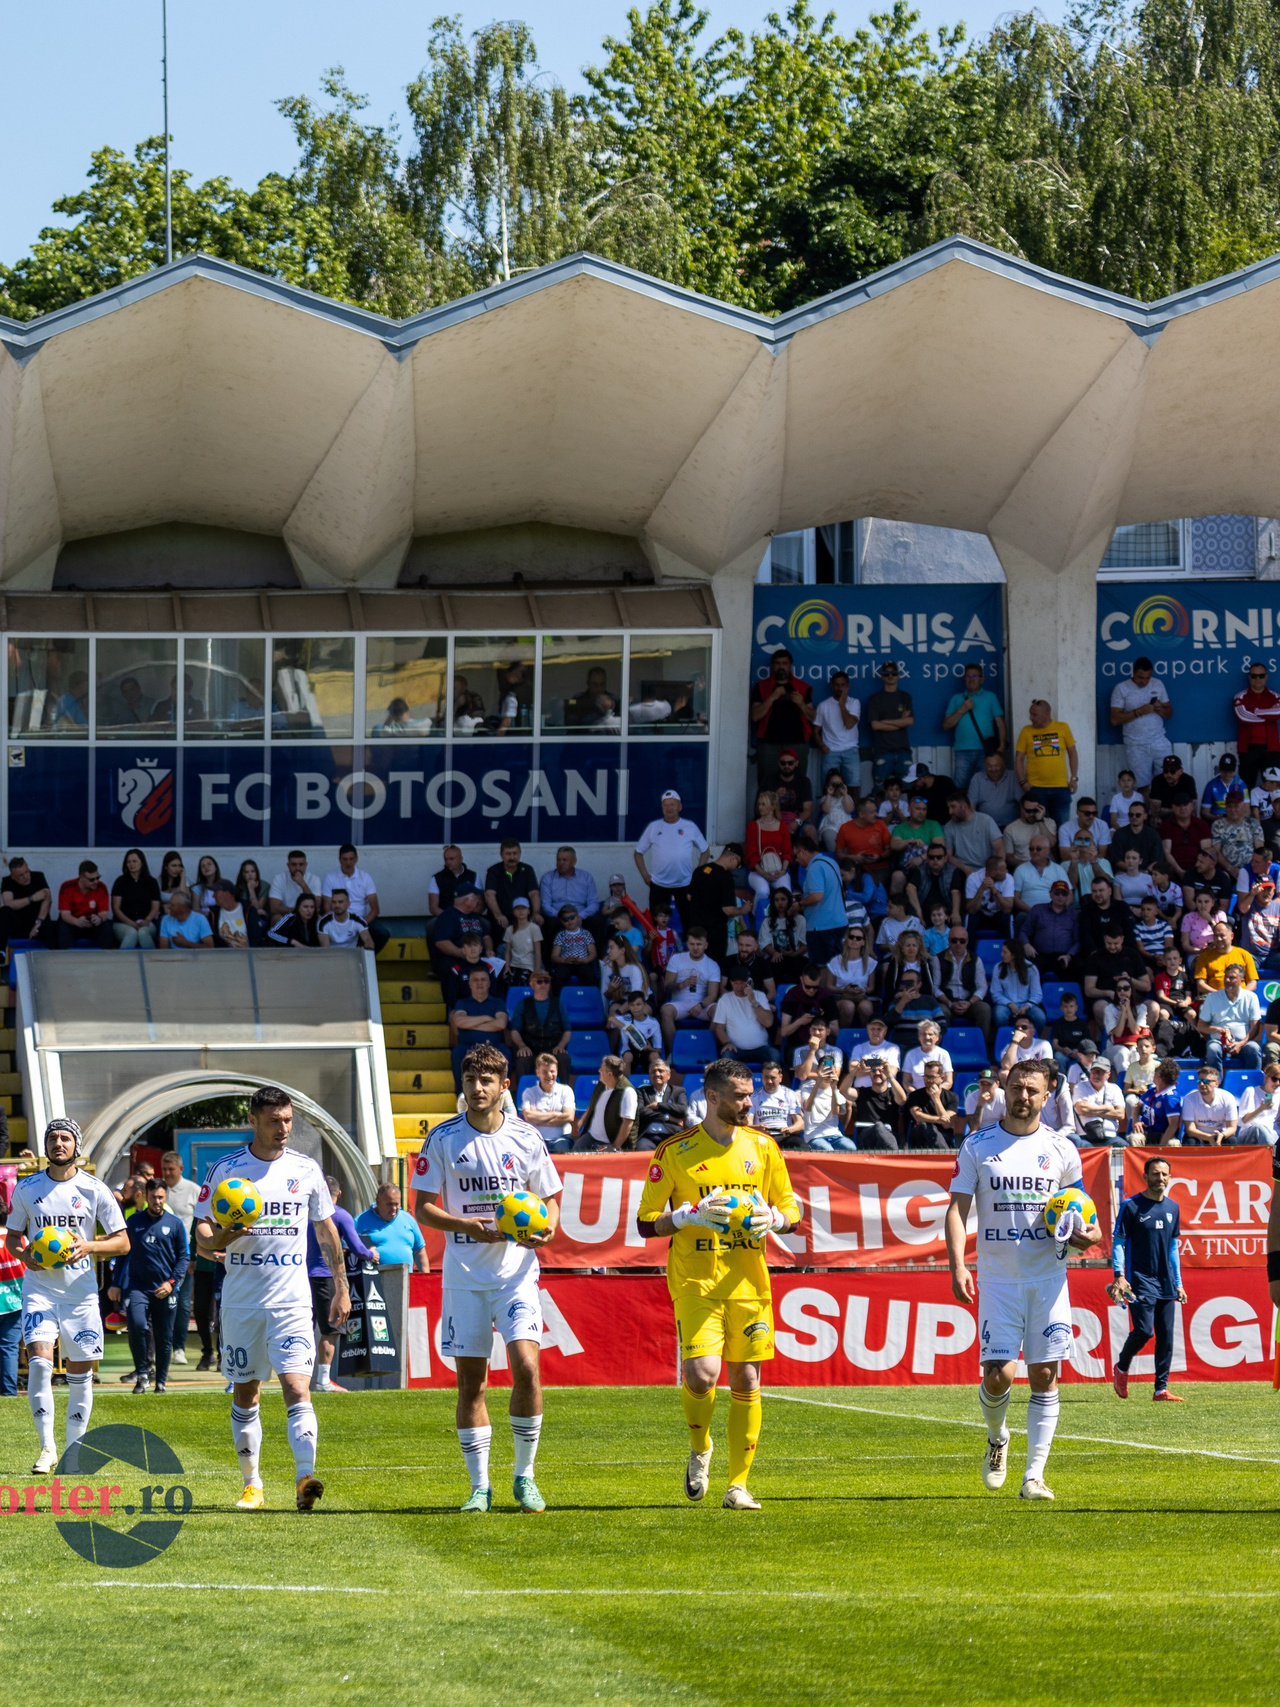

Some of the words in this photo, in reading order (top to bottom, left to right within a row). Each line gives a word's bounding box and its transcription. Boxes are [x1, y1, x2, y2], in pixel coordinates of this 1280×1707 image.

[1100, 595, 1280, 651] CORNI
[757, 659, 883, 683] auapark
[923, 658, 999, 682] spots
[1102, 655, 1229, 679] aqapark
[199, 772, 272, 821] FC
[294, 768, 629, 830] BOTOȘANI
[398, 943, 406, 958] 7
[406, 1030, 416, 1045] 5
[412, 1074, 422, 1090] 4
[420, 1120, 429, 1134] 3
[459, 1176, 518, 1192] UNIBET
[990, 1176, 1055, 1192] UNIBET
[263, 1202, 302, 1216] IBET
[35, 1216, 85, 1228] UNIBET
[272, 1227, 287, 1235] SPRE
[230, 1253, 302, 1266] ELSACO
[366, 1302, 386, 1310] SELECT
[24, 1311, 43, 1331] 20
[375, 1330, 387, 1339] LPF
[982, 1320, 990, 1344] 4
[226, 1345, 248, 1369] 30
[238, 1369, 255, 1377] Vestra
